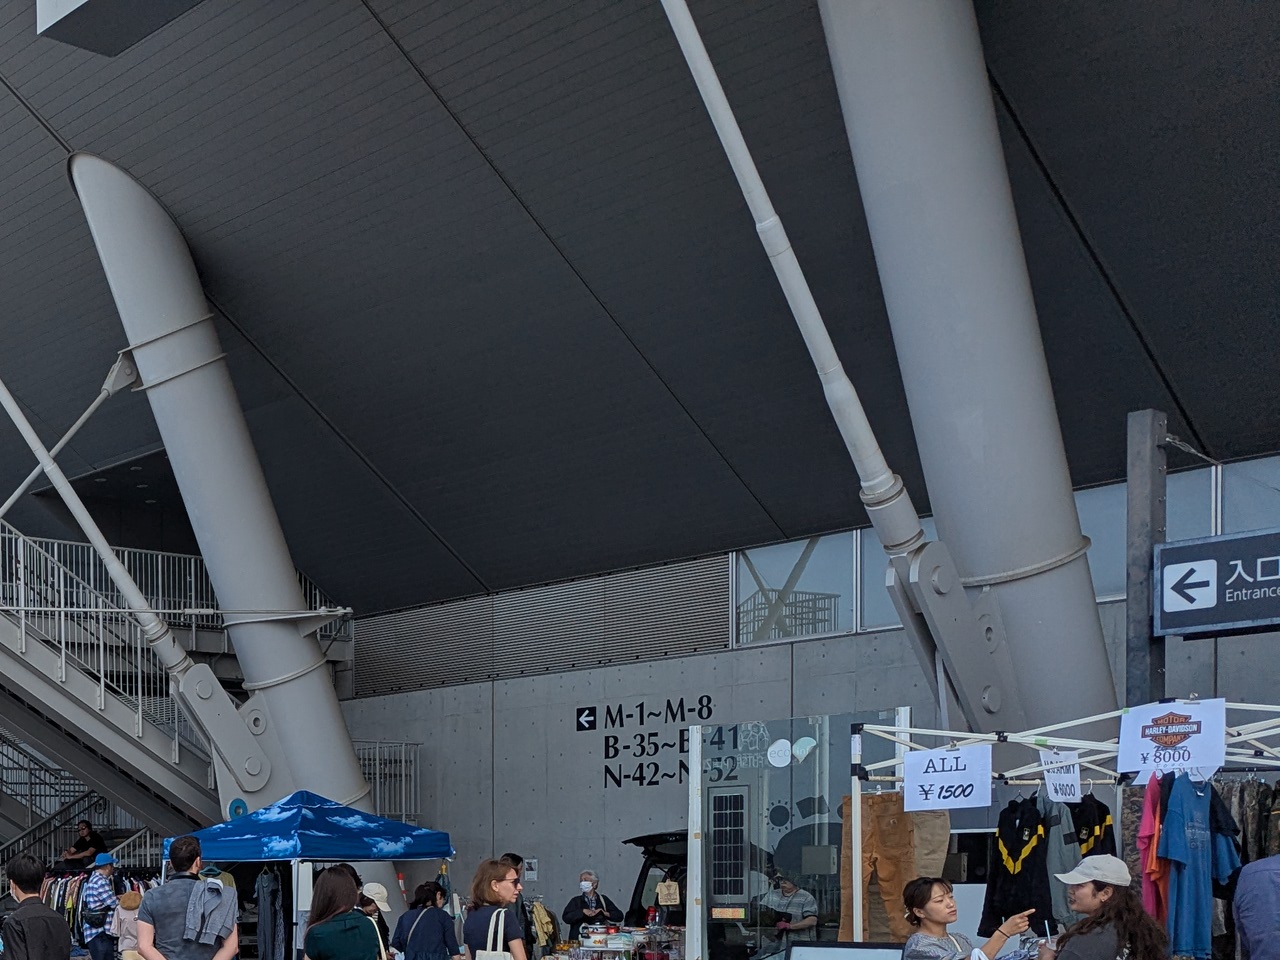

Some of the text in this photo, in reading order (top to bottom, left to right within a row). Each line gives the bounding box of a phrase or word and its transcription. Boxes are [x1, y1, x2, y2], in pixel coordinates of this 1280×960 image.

[1225, 556, 1280, 585] 入口
[1157, 715, 1186, 725] MOTOR
[1145, 724, 1198, 735] HARLEY-DAVIDSON
[1156, 735, 1186, 745] COMPANY
[769, 748, 791, 758] eco
[922, 756, 966, 774] ALL
